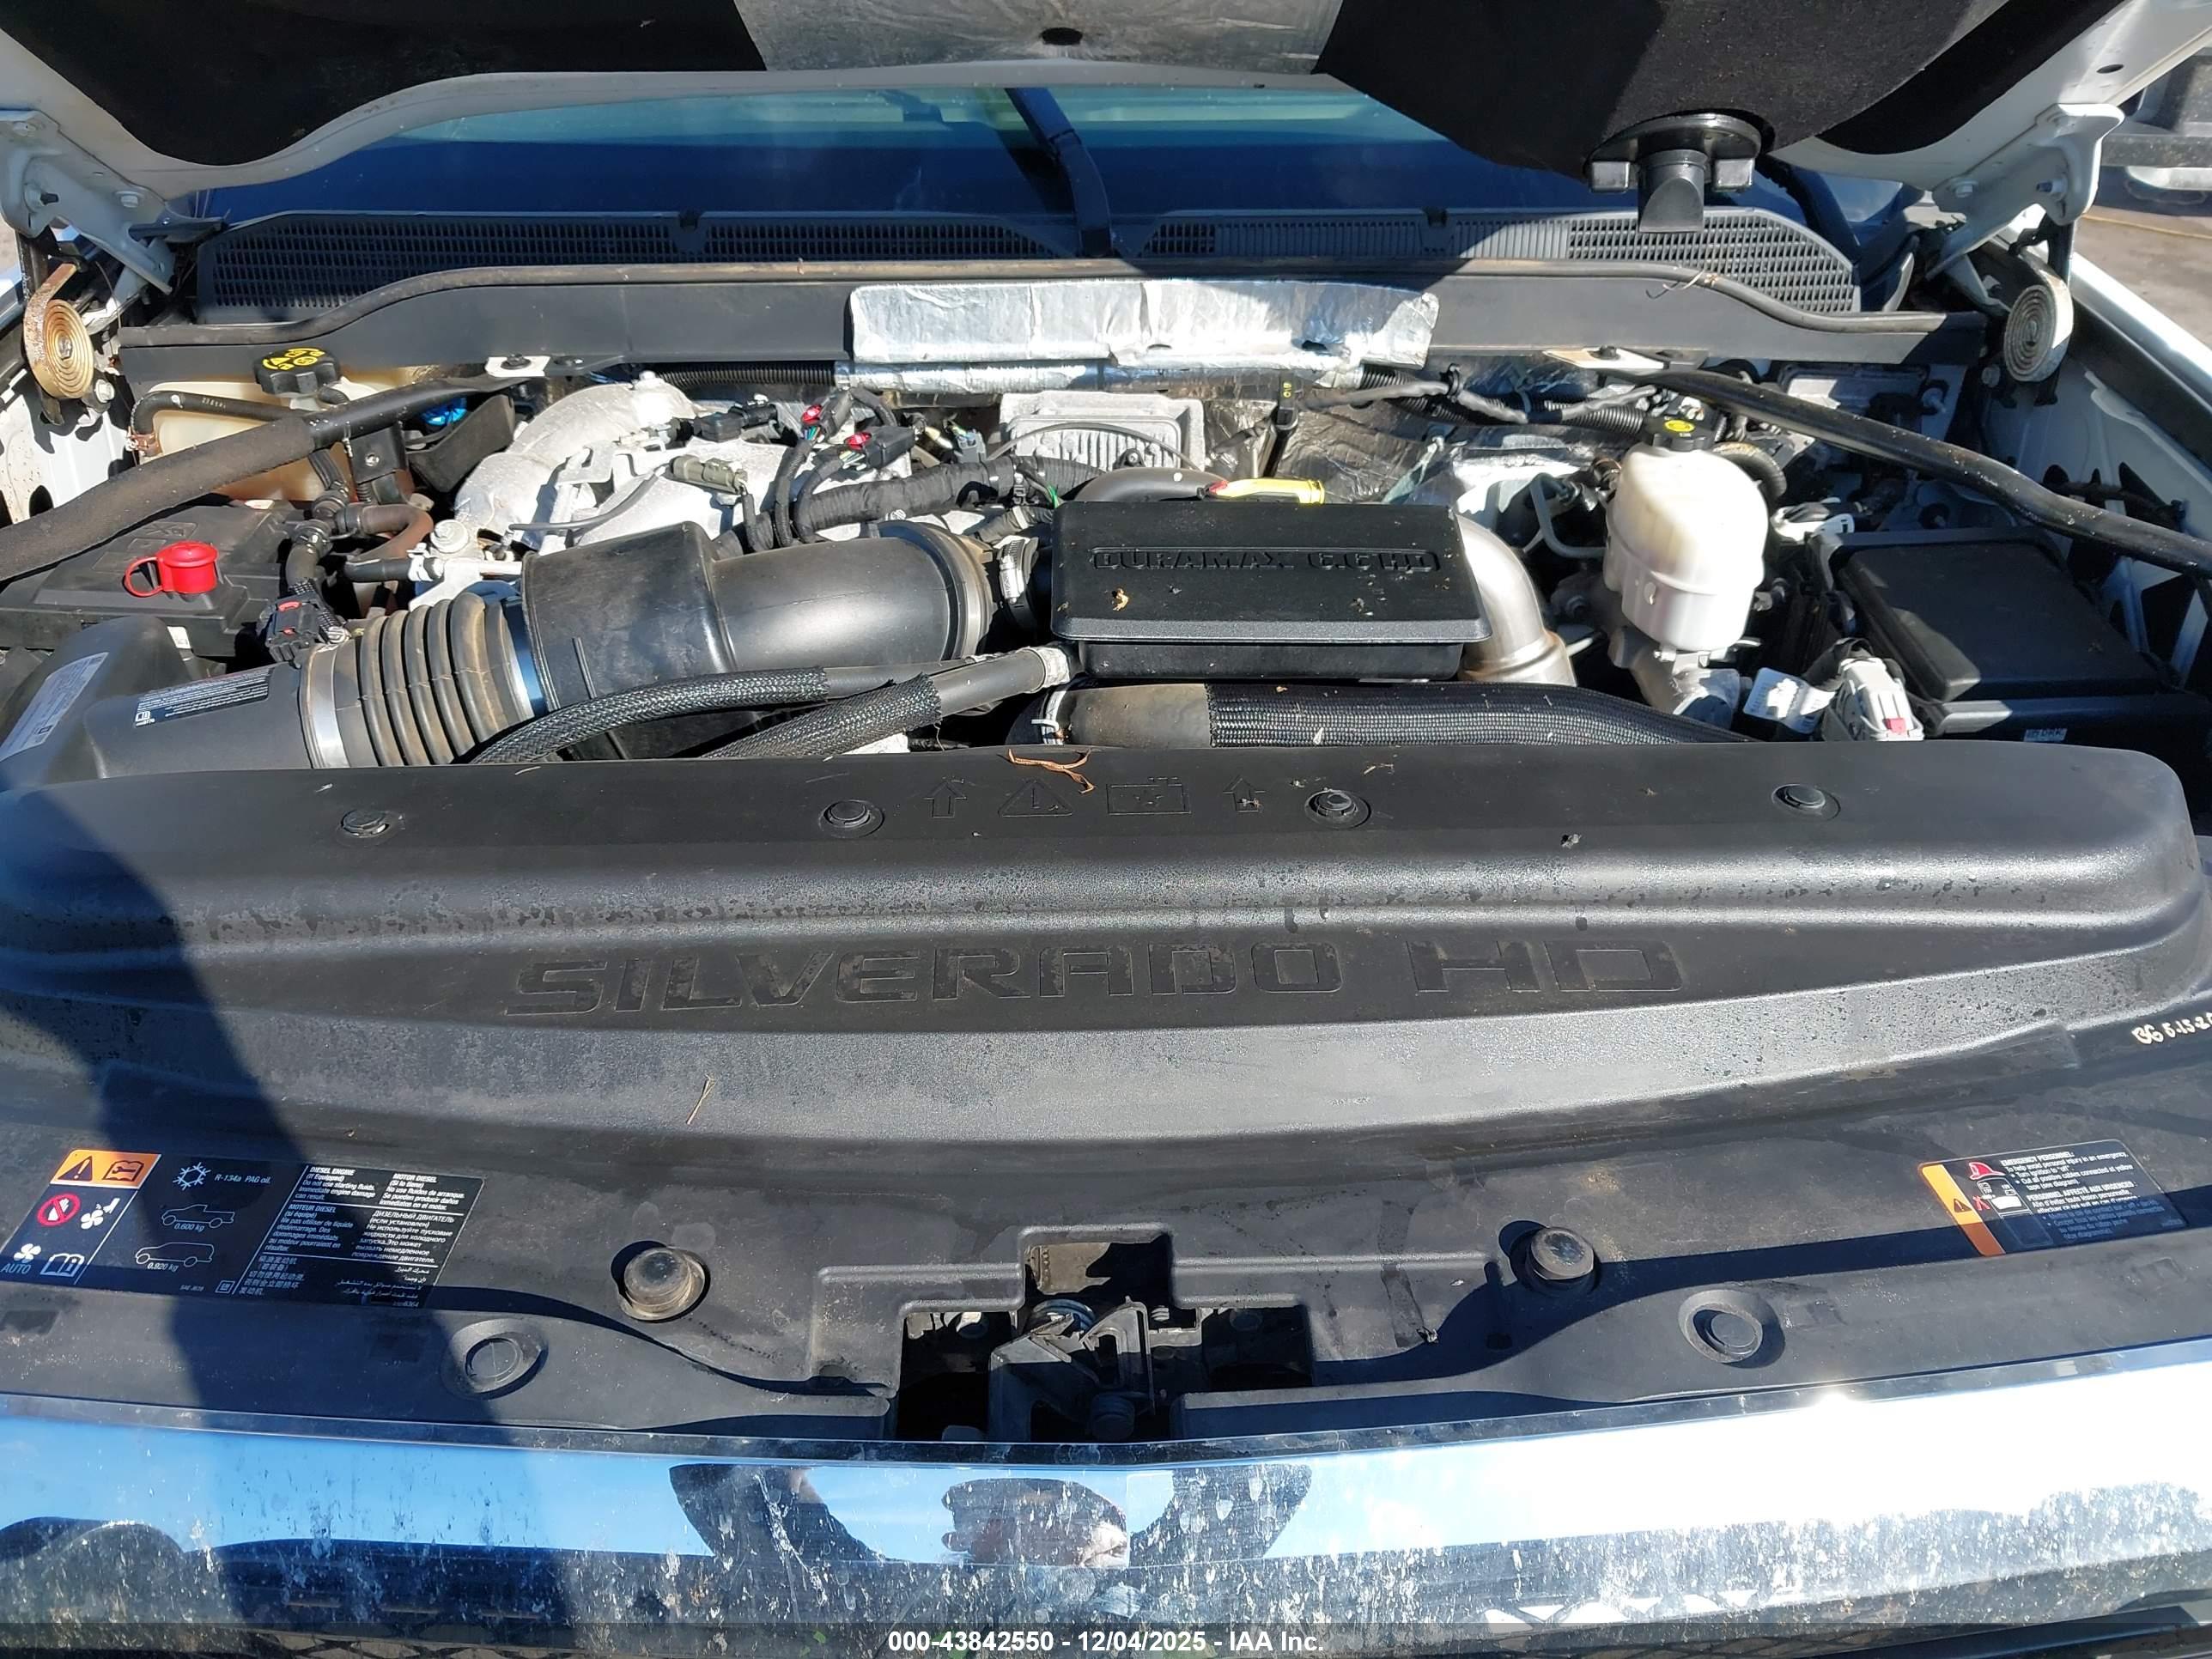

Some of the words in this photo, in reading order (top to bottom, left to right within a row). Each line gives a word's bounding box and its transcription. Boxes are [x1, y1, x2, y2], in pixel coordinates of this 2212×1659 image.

[1091, 549, 1294, 571] DURAMAX
[506, 941, 1345, 1015] SILVERADO
[1405, 939, 1684, 993] HD
[215, 1174, 242, 1182] R-134a
[245, 1175, 260, 1183] PAG
[351, 1189, 375, 1198] damage
[372, 1210, 416, 1219] ДИЗЕЛЬНЫЙ
[416, 1213, 455, 1223] ДВИГАТЕЛЬ
[0, 1263, 32, 1274] AUTO
[147, 1261, 167, 1271] 0.920
[168, 1263, 179, 1273] kg
